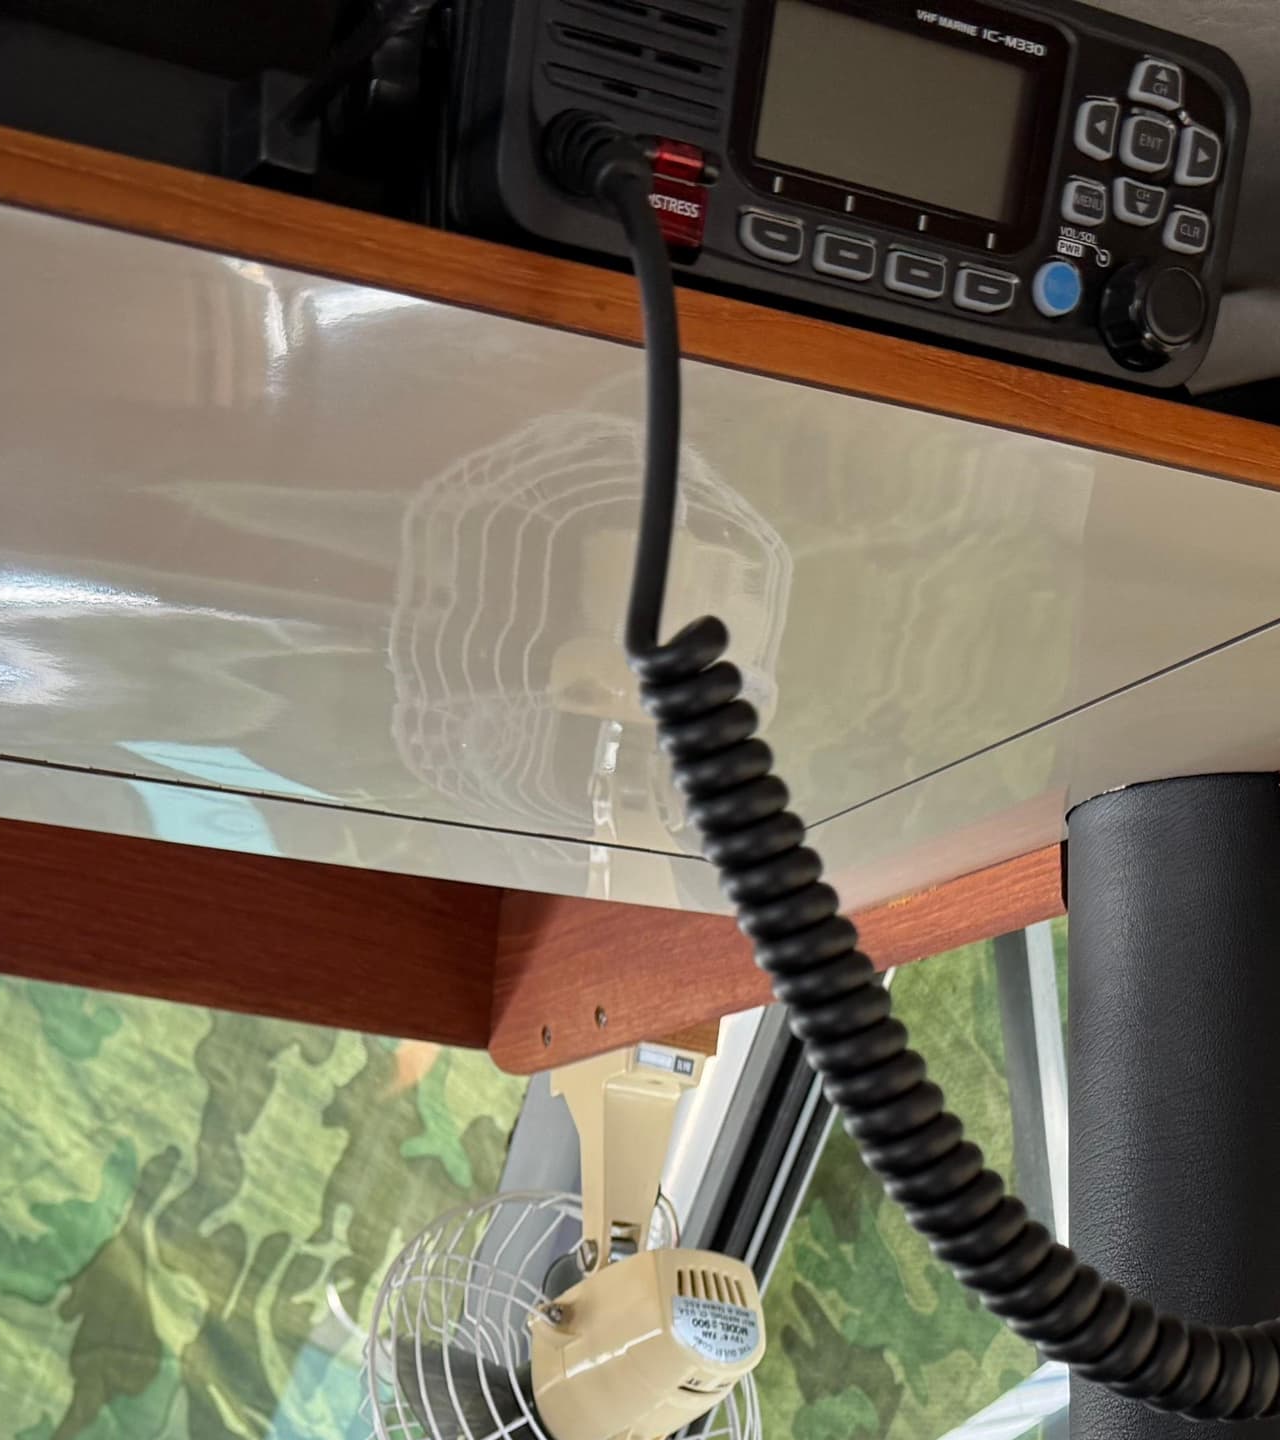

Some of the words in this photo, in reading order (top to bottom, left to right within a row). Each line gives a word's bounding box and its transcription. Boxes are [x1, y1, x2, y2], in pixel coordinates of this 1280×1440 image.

[938, 16, 978, 37] MARINE
[982, 28, 1047, 57] IC-M330
[1138, 132, 1164, 150] ENT
[648, 193, 703, 219] ISTRESS
[1179, 223, 1201, 241] CLR
